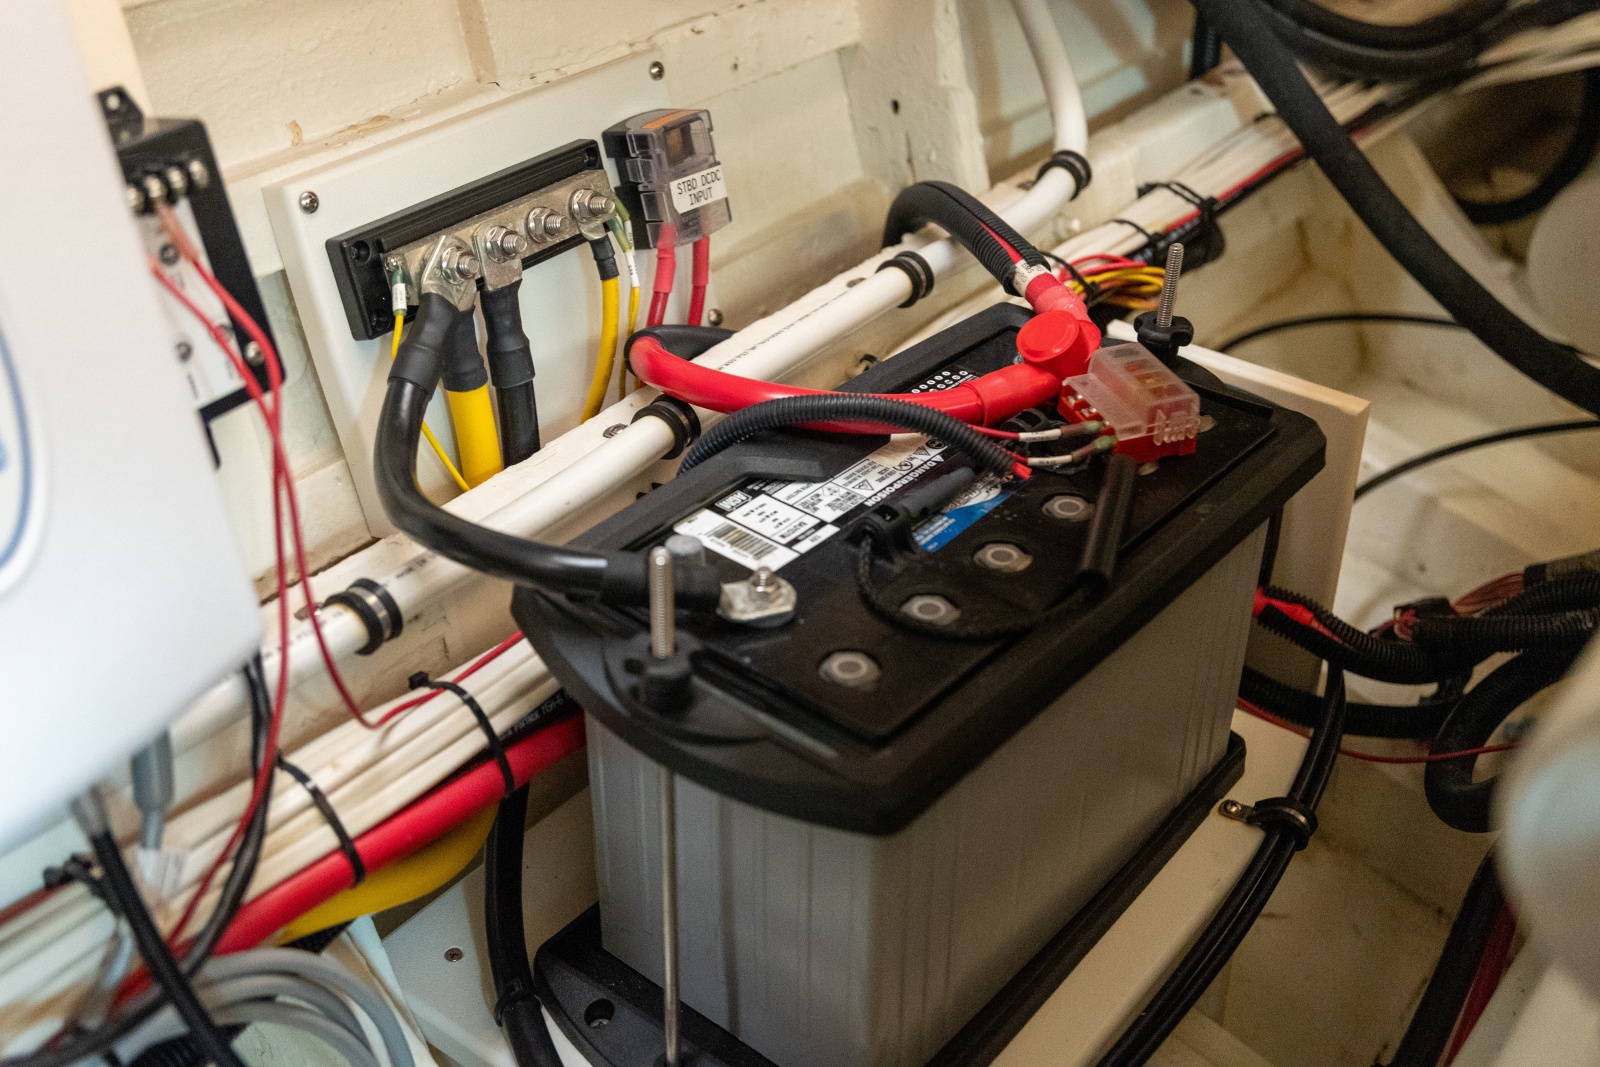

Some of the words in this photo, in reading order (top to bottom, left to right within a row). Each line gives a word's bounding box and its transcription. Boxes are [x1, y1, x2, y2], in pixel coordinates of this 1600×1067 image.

[677, 178, 697, 195] STBD
[701, 169, 721, 186] DCDC
[689, 186, 713, 206] INPUT
[717, 491, 748, 509] AGM
